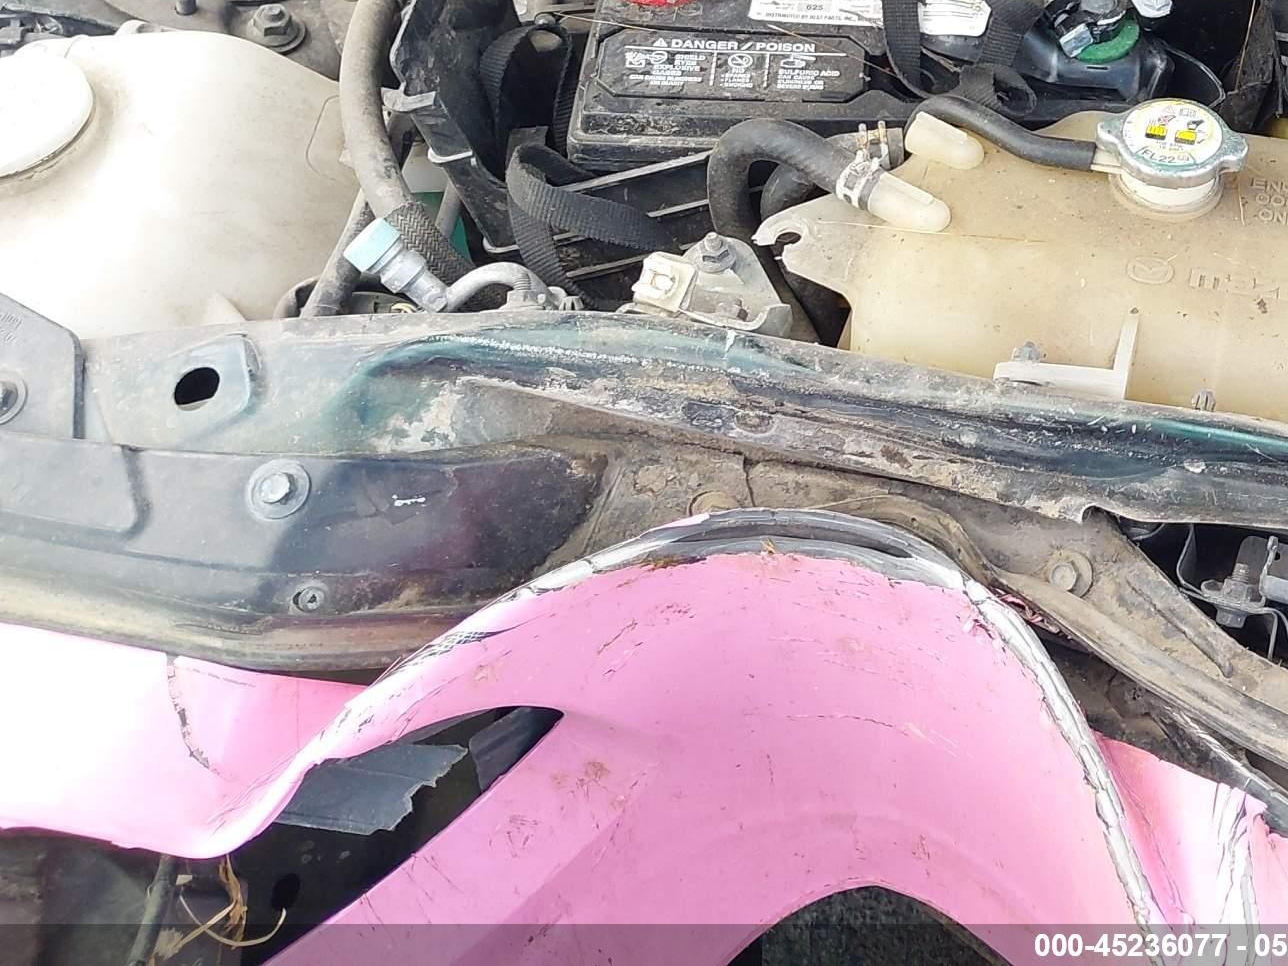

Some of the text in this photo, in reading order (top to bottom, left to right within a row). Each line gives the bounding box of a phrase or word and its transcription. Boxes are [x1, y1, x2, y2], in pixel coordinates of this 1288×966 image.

[671, 39, 739, 50] DANGER
[756, 42, 816, 53] POISON
[1141, 148, 1176, 164] FL22
